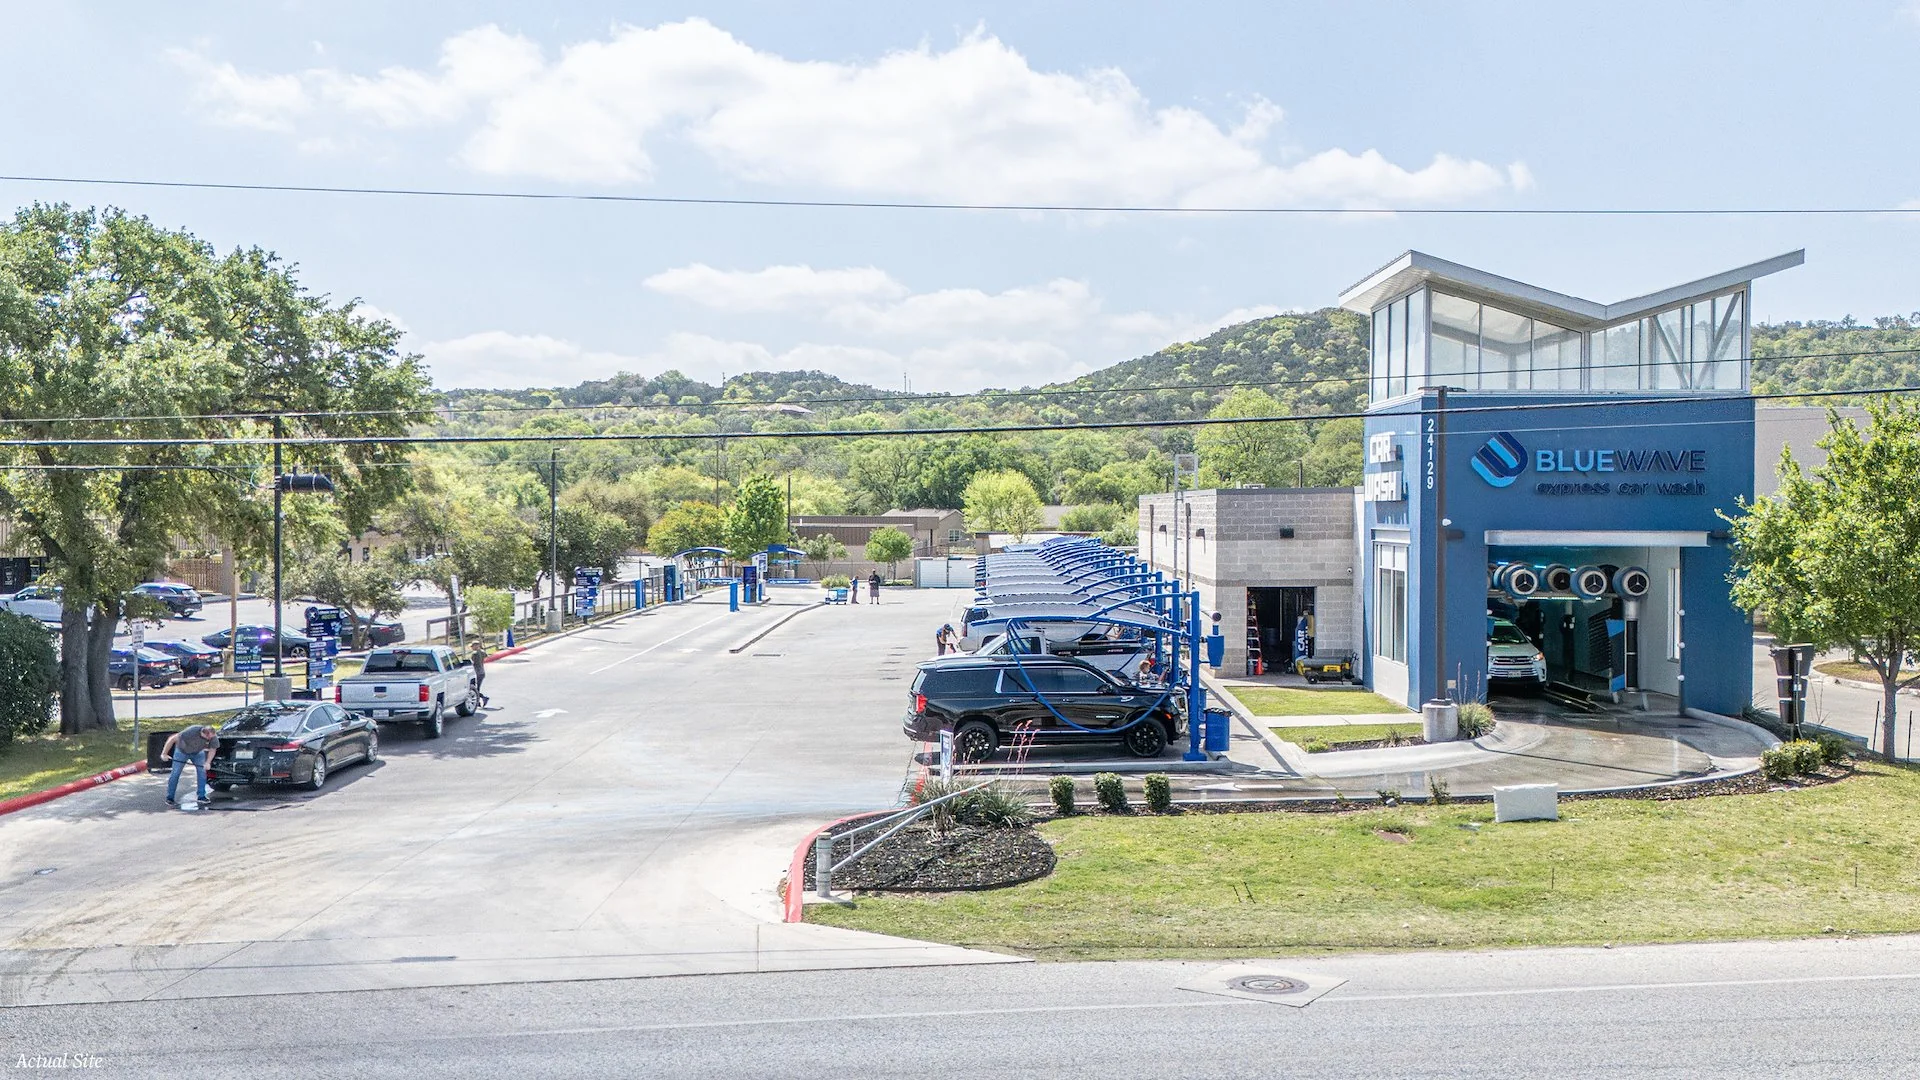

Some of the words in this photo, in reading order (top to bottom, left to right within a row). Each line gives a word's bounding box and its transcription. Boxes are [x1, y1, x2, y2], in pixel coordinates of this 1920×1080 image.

[1427, 418, 1435, 490] 24129
[1536, 449, 1706, 472] BLUEWAVE
[1536, 481, 1611, 496] express
[1616, 481, 1650, 496] car
[1656, 478, 1707, 496] wash
